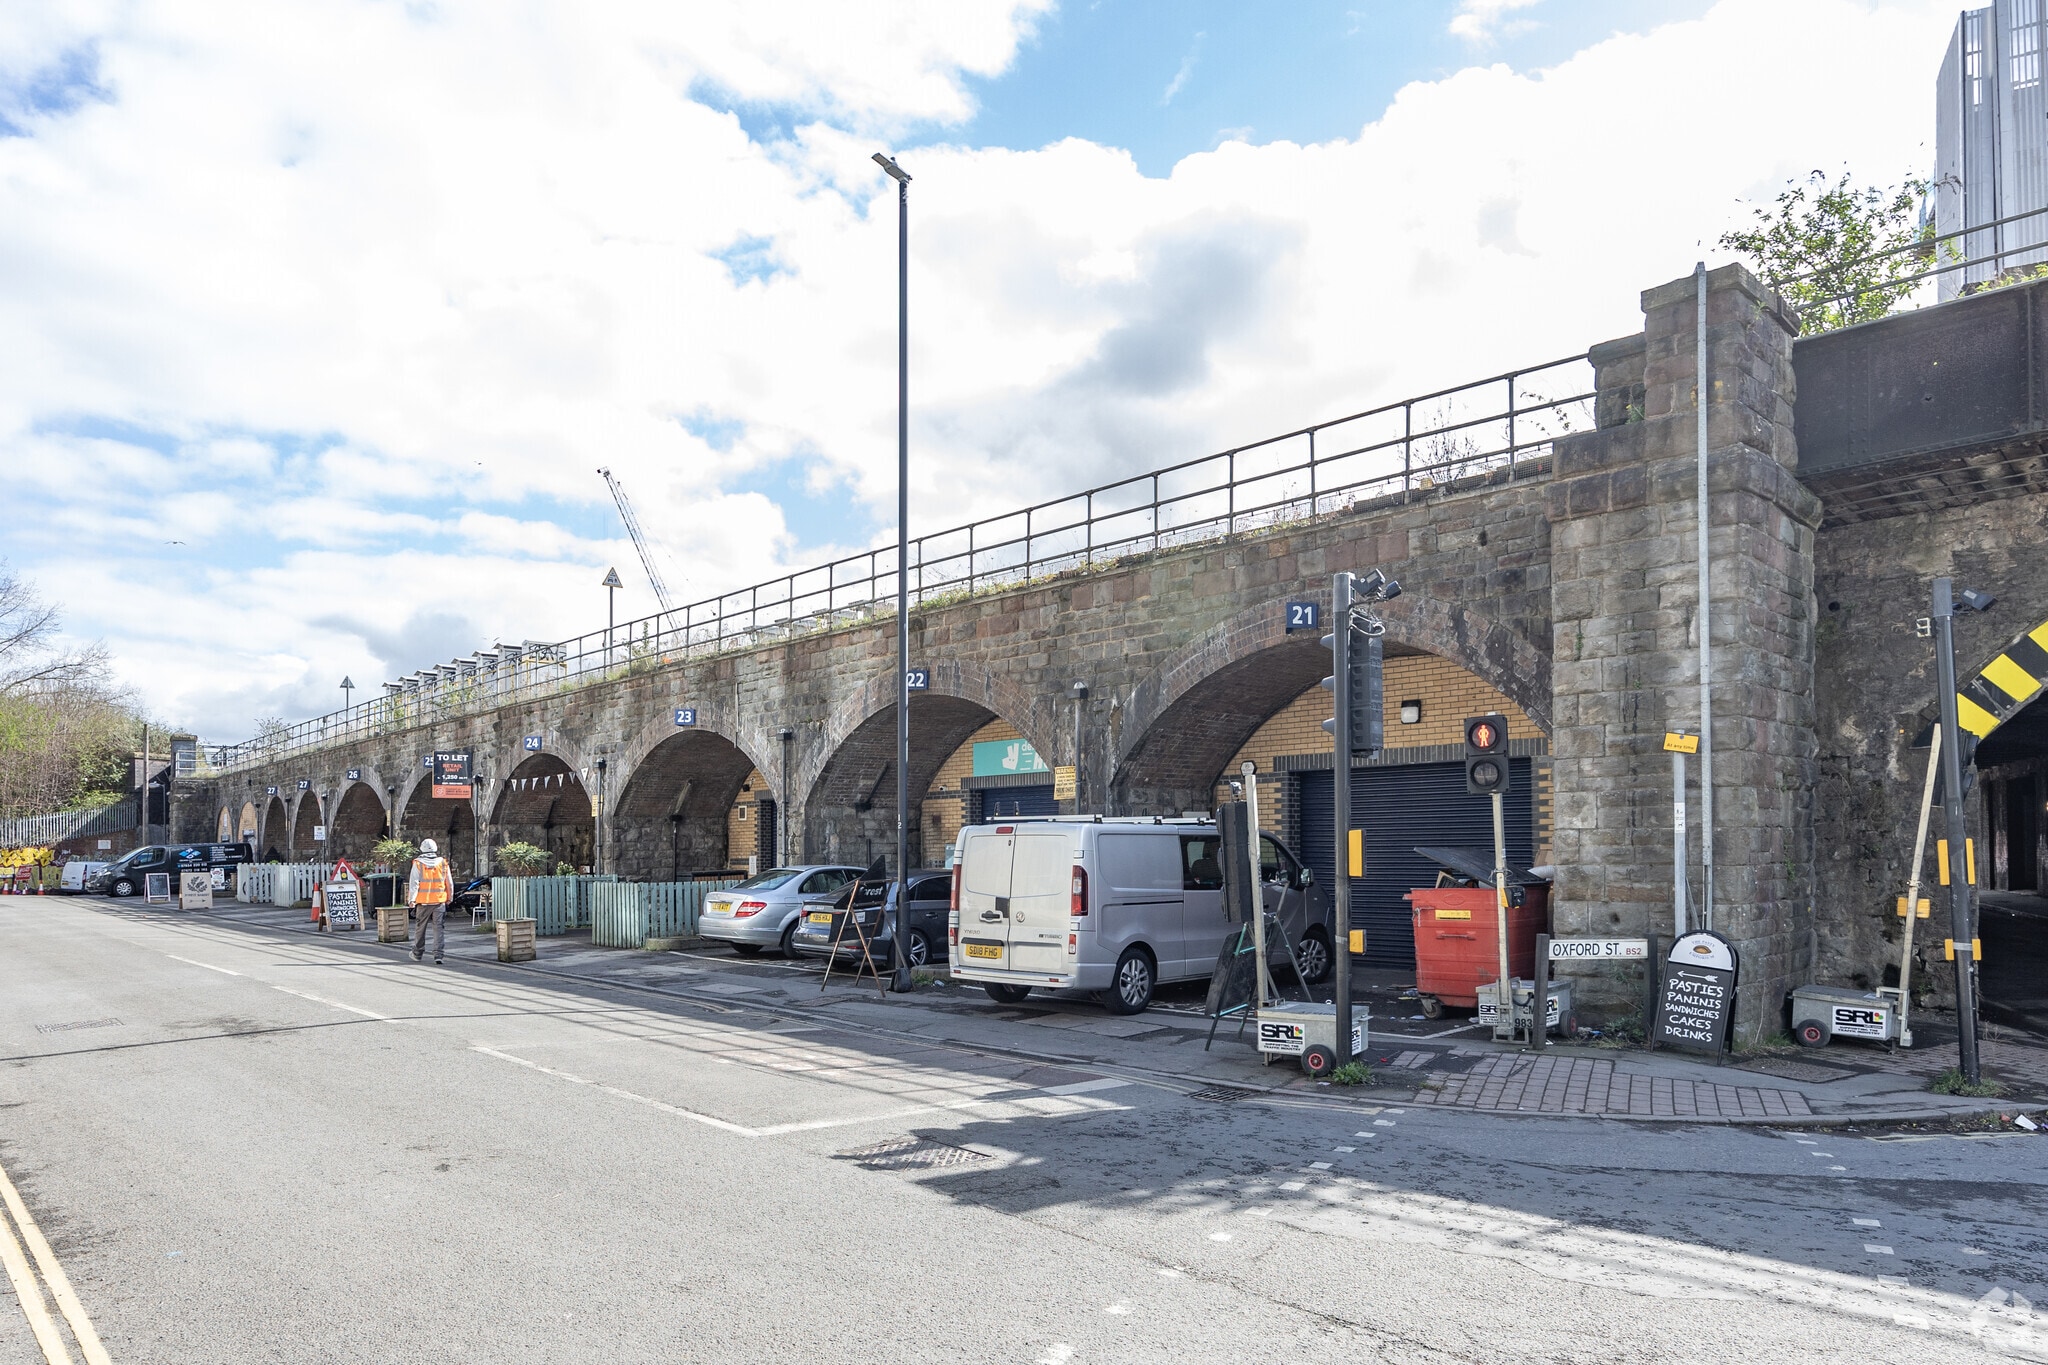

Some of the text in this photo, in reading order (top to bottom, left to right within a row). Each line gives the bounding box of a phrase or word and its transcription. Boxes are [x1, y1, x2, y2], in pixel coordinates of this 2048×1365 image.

[1292, 606, 1312, 624] 21
[907, 673, 924, 687] 22
[677, 711, 692, 722] 23
[526, 738, 538, 747] 24
[327, 892, 357, 900] PASTIES
[983, 947, 998, 957] FHG
[1553, 943, 1600, 956] OXFORD
[1605, 943, 1622, 955] ST.
[1669, 978, 1724, 997] PASTIES
[1546, 1000, 1558, 1013] RL
[1667, 991, 1721, 1009] PANINIS
[1480, 1004, 1497, 1013] SR
[1665, 1003, 1720, 1019] SANDWICHES
[1514, 1018, 1533, 1028] 983
[1669, 1015, 1711, 1030] CAKES
[1836, 1009, 1883, 1025] SRL
[1261, 1023, 1303, 1040] SRL
[1665, 1026, 1713, 1042] DRINKS
